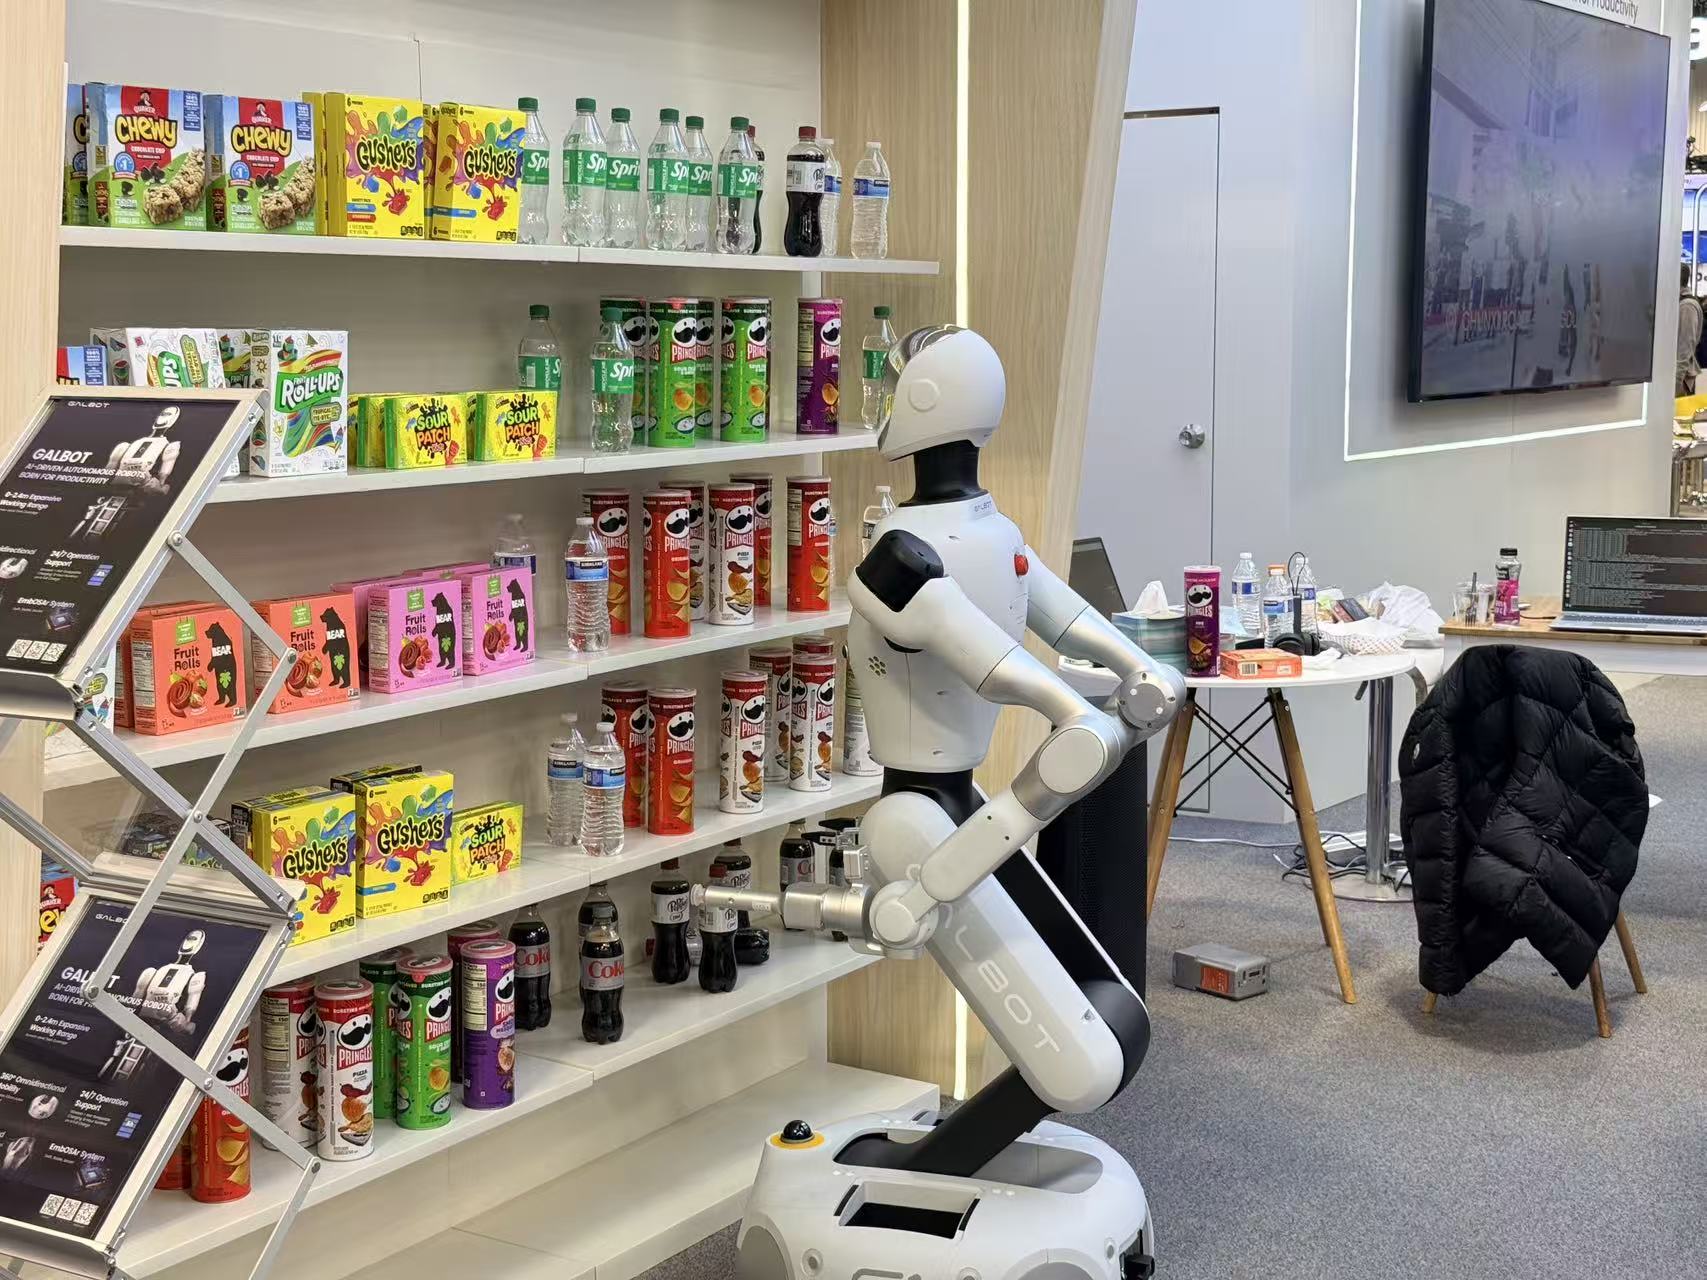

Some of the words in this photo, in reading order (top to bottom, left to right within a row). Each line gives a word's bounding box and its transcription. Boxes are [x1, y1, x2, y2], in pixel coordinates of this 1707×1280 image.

[357, 136, 416, 173] Gushers
[464, 145, 516, 180] Gushers
[609, 160, 640, 178] Spri
[691, 166, 712, 184] Spr
[610, 362, 634, 382] Spr
[417, 411, 448, 431] SOUR
[506, 407, 538, 425] SOUR
[417, 427, 450, 449] PATCH
[505, 422, 540, 443] PATCH
[32, 448, 93, 464] GALBOT
[25, 464, 64, 473] AI-DRIVEN
[64, 466, 115, 476] AUTONOMOUS
[56, 474, 109, 484] PRODUCTIVITY
[30, 494, 62, 502] Expansive
[26, 502, 48, 510] Range
[44, 558, 72, 567] Support
[50, 550, 66, 558] 24/7
[66, 551, 100, 560] Operation
[50, 600, 75, 608] System
[486, 600, 503, 612] Fruit
[406, 614, 426, 626] Fruit
[436, 612, 452, 624] BEAR
[487, 610, 504, 621] Rolls
[290, 630, 314, 644] Fruit
[326, 628, 346, 640] BEAR
[406, 624, 426, 636] Rolls
[174, 646, 200, 660] Fruit
[212, 644, 232, 657] BEAR
[174, 656, 200, 671] Rolls
[378, 814, 444, 854] Gushers
[471, 824, 504, 848] SOUR
[282, 837, 348, 879] Gushers
[470, 838, 505, 865] PATCH
[62, 966, 120, 989] GALT
[48, 992, 70, 1004] BORN
[70, 996, 86, 1006] FOR
[34, 1015, 58, 1026] 0-2.4m
[59, 1018, 91, 1032] Expansive
[30, 1024, 58, 1037] Working
[56, 1028, 78, 1040] Range
[353, 1069, 368, 1078] PIZZA
[16, 1076, 67, 1094] Omnidirectional
[75, 1100, 102, 1112] Support
[80, 1090, 96, 1100] 24/7
[96, 1093, 129, 1108] Operation
[49, 1143, 81, 1157] EmbOSAr
[81, 1150, 106, 1163] System
